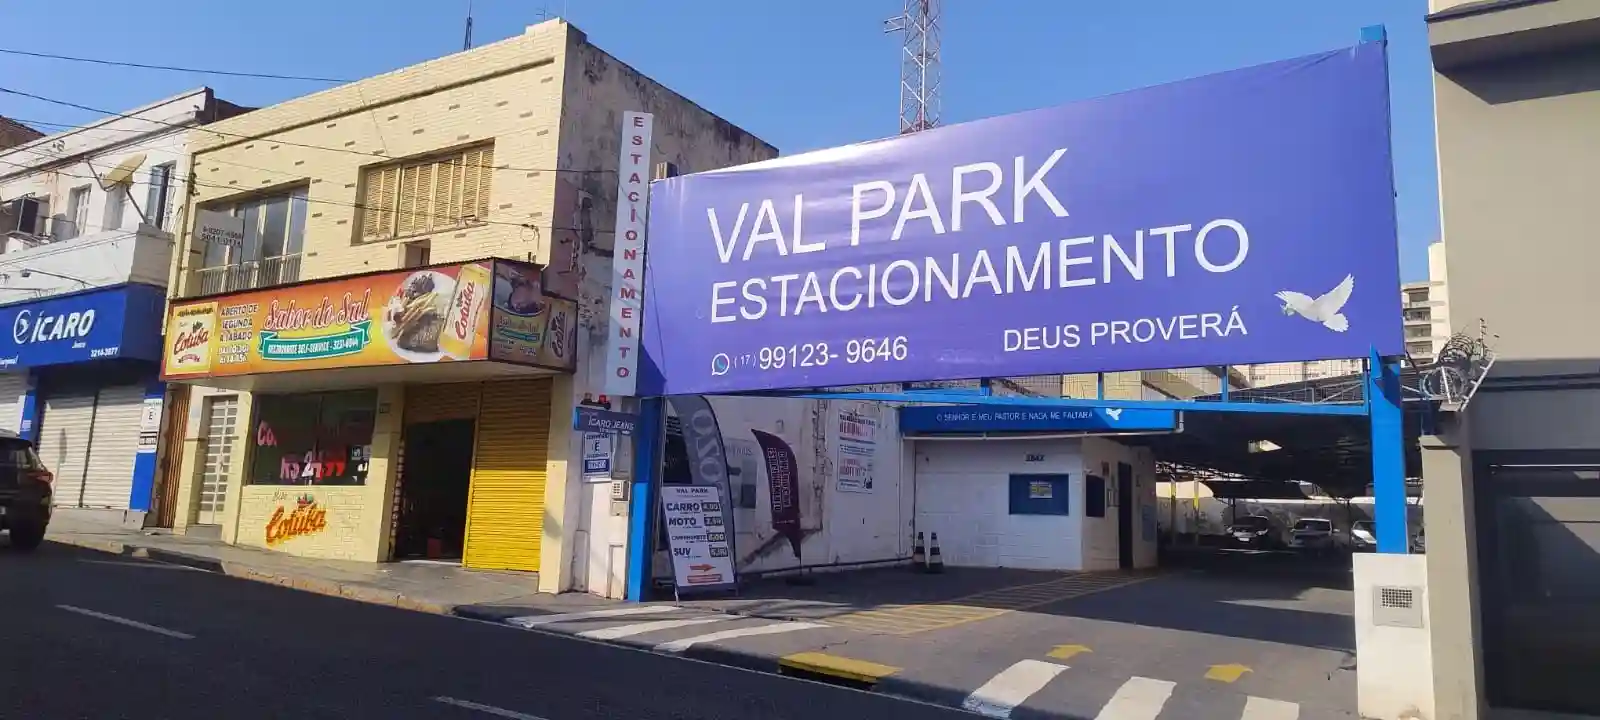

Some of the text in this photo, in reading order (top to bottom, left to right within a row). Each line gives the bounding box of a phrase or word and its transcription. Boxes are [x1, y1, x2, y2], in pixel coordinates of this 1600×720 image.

[707, 148, 1070, 264] VAL PARK
[710, 218, 1249, 323] ESTACIONAMENTO
[264, 288, 371, 329] Sabor do Sul
[455, 280, 475, 340] Cotuba
[30, 309, 95, 343] ÍCARO
[174, 328, 209, 355] Cotuba
[1004, 305, 1248, 352] DEUS PROVERÁ
[846, 336, 908, 363] 9646
[994, 412, 1020, 420] PASTOR
[1022, 412, 1027, 420] E
[1050, 411, 1061, 419] ME
[666, 502, 700, 512] CARRO
[669, 517, 696, 526] MOTO
[266, 505, 327, 545] Cotuba
[674, 547, 691, 556] SUV
